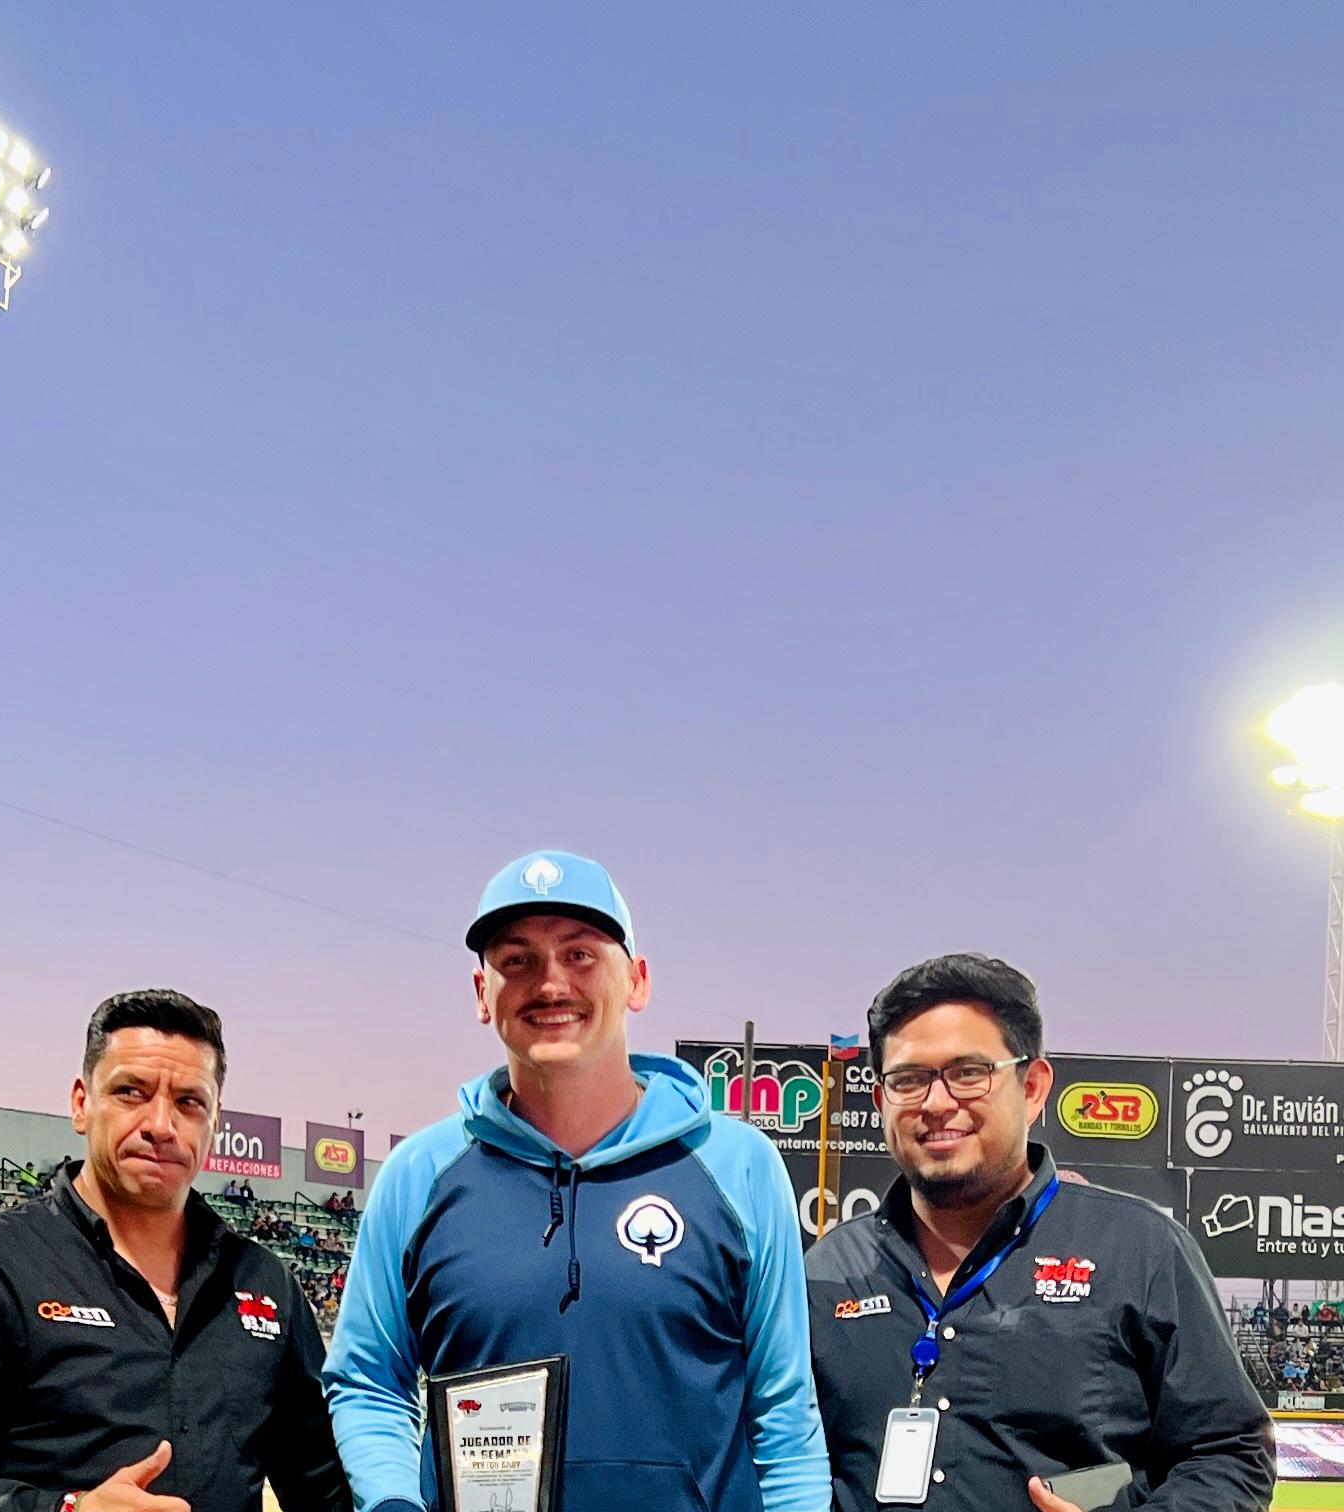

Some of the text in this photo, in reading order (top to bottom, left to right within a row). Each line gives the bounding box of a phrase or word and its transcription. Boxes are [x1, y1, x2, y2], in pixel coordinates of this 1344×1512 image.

[842, 1110, 868, 1128] 687
[1242, 1095, 1268, 1122] Dr.
[1273, 1095, 1338, 1124] Favián
[1243, 1124, 1308, 1137] SALVAMENTO
[1311, 1126, 1330, 1137] DEL
[214, 1122, 264, 1160] rion
[208, 1158, 280, 1178] REFACCIONES
[1256, 1238, 1297, 1253] Entre
[1301, 1239, 1317, 1254] tú
[1317, 1243, 1330, 1258] y
[460, 1436, 514, 1448] JUGADOR
